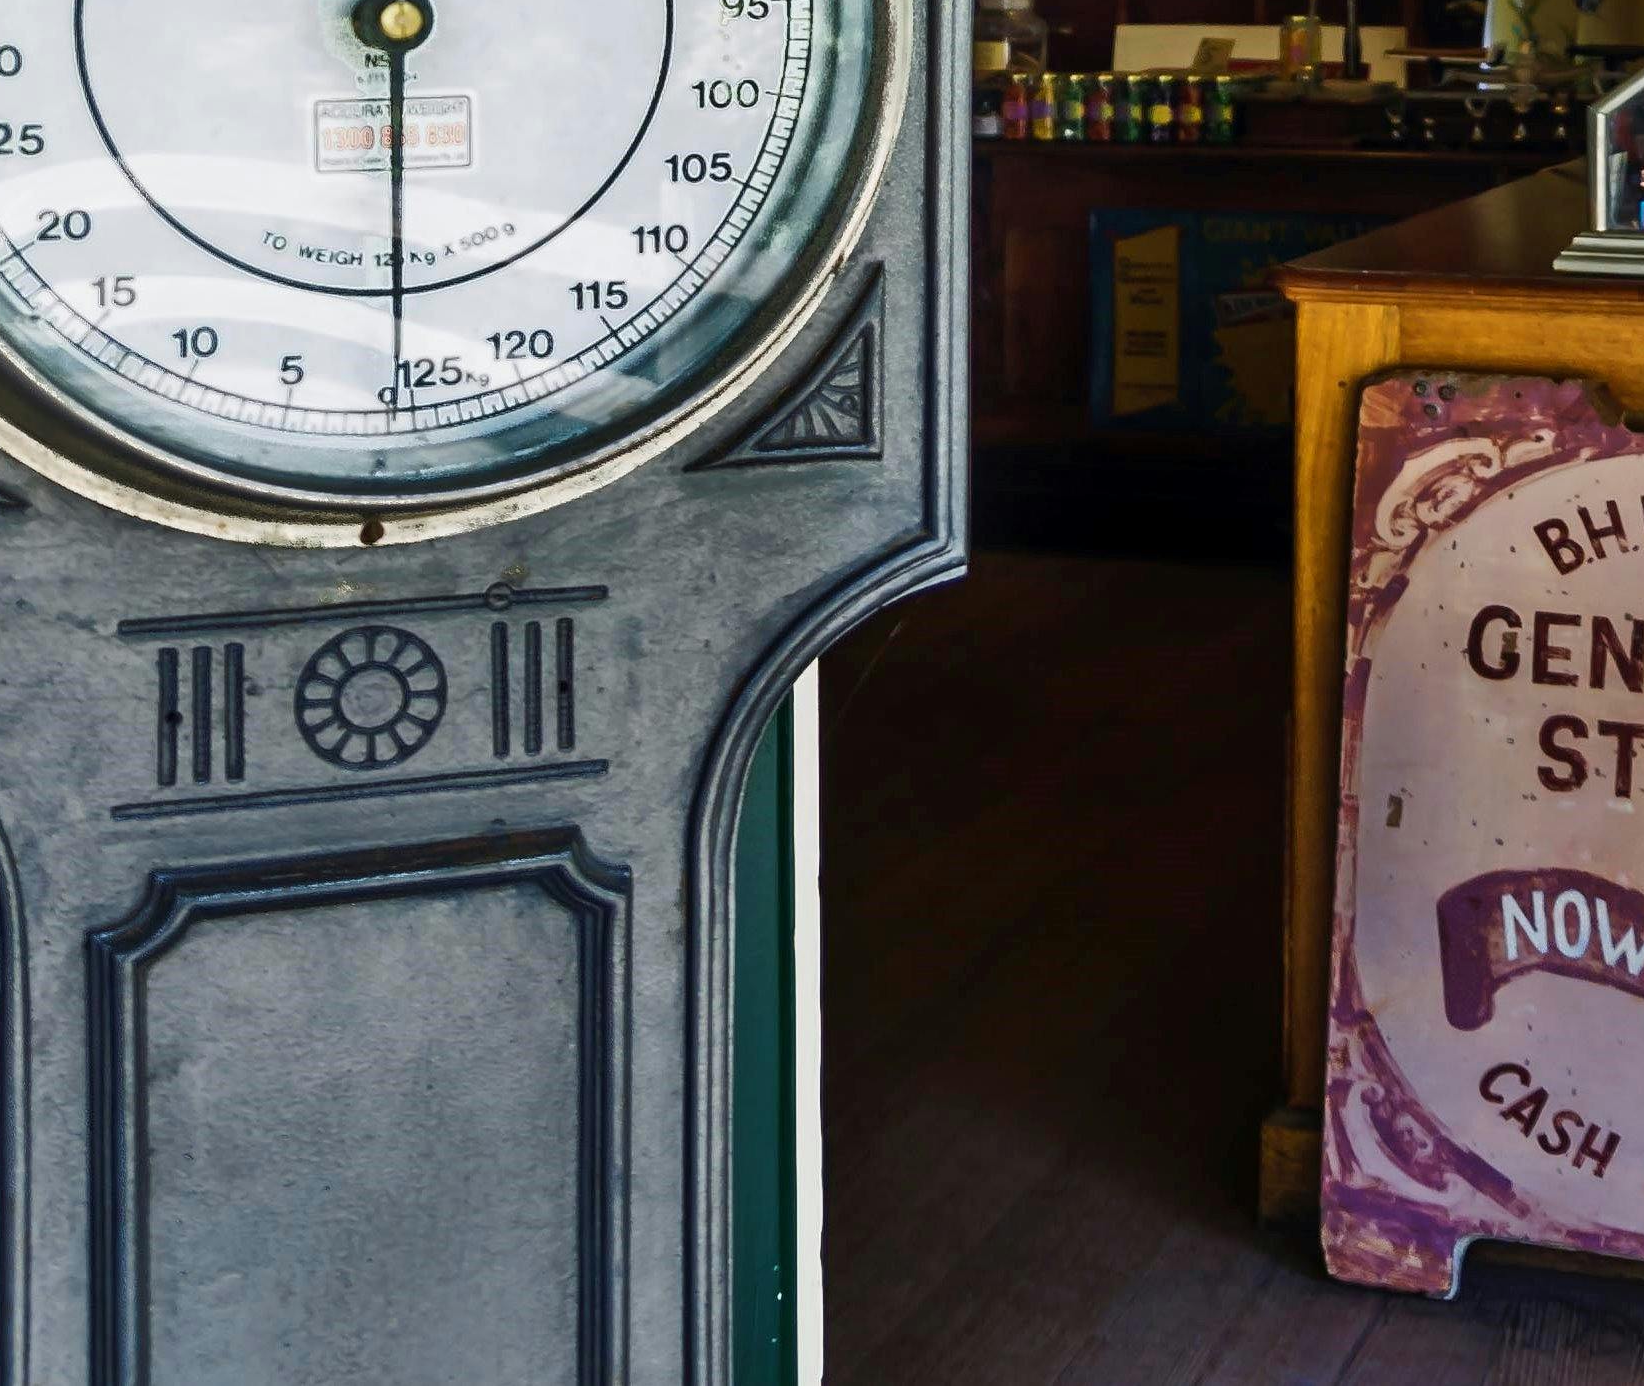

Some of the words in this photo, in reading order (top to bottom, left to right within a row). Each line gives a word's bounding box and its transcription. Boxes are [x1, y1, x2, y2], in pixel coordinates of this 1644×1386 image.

[320, 103, 395, 118] ACCURAT
[691, 80, 760, 112] 100
[325, 126, 374, 150] 1300
[381, 125, 419, 149] 85
[427, 122, 465, 146] 830
[663, 150, 733, 185] 105
[37, 209, 93, 244] 20
[632, 224, 690, 255] 110
[262, 231, 287, 251] TO
[298, 246, 363, 266] WEIGH
[375, 253, 403, 267] 12
[461, 226, 498, 250] 500
[503, 223, 516, 236] g
[92, 277, 137, 309] 15
[568, 280, 630, 313] 115
[173, 326, 219, 359] 10
[486, 328, 555, 361] 120
[278, 356, 305, 387] 5
[1478, 1060, 1622, 1178] CASH
